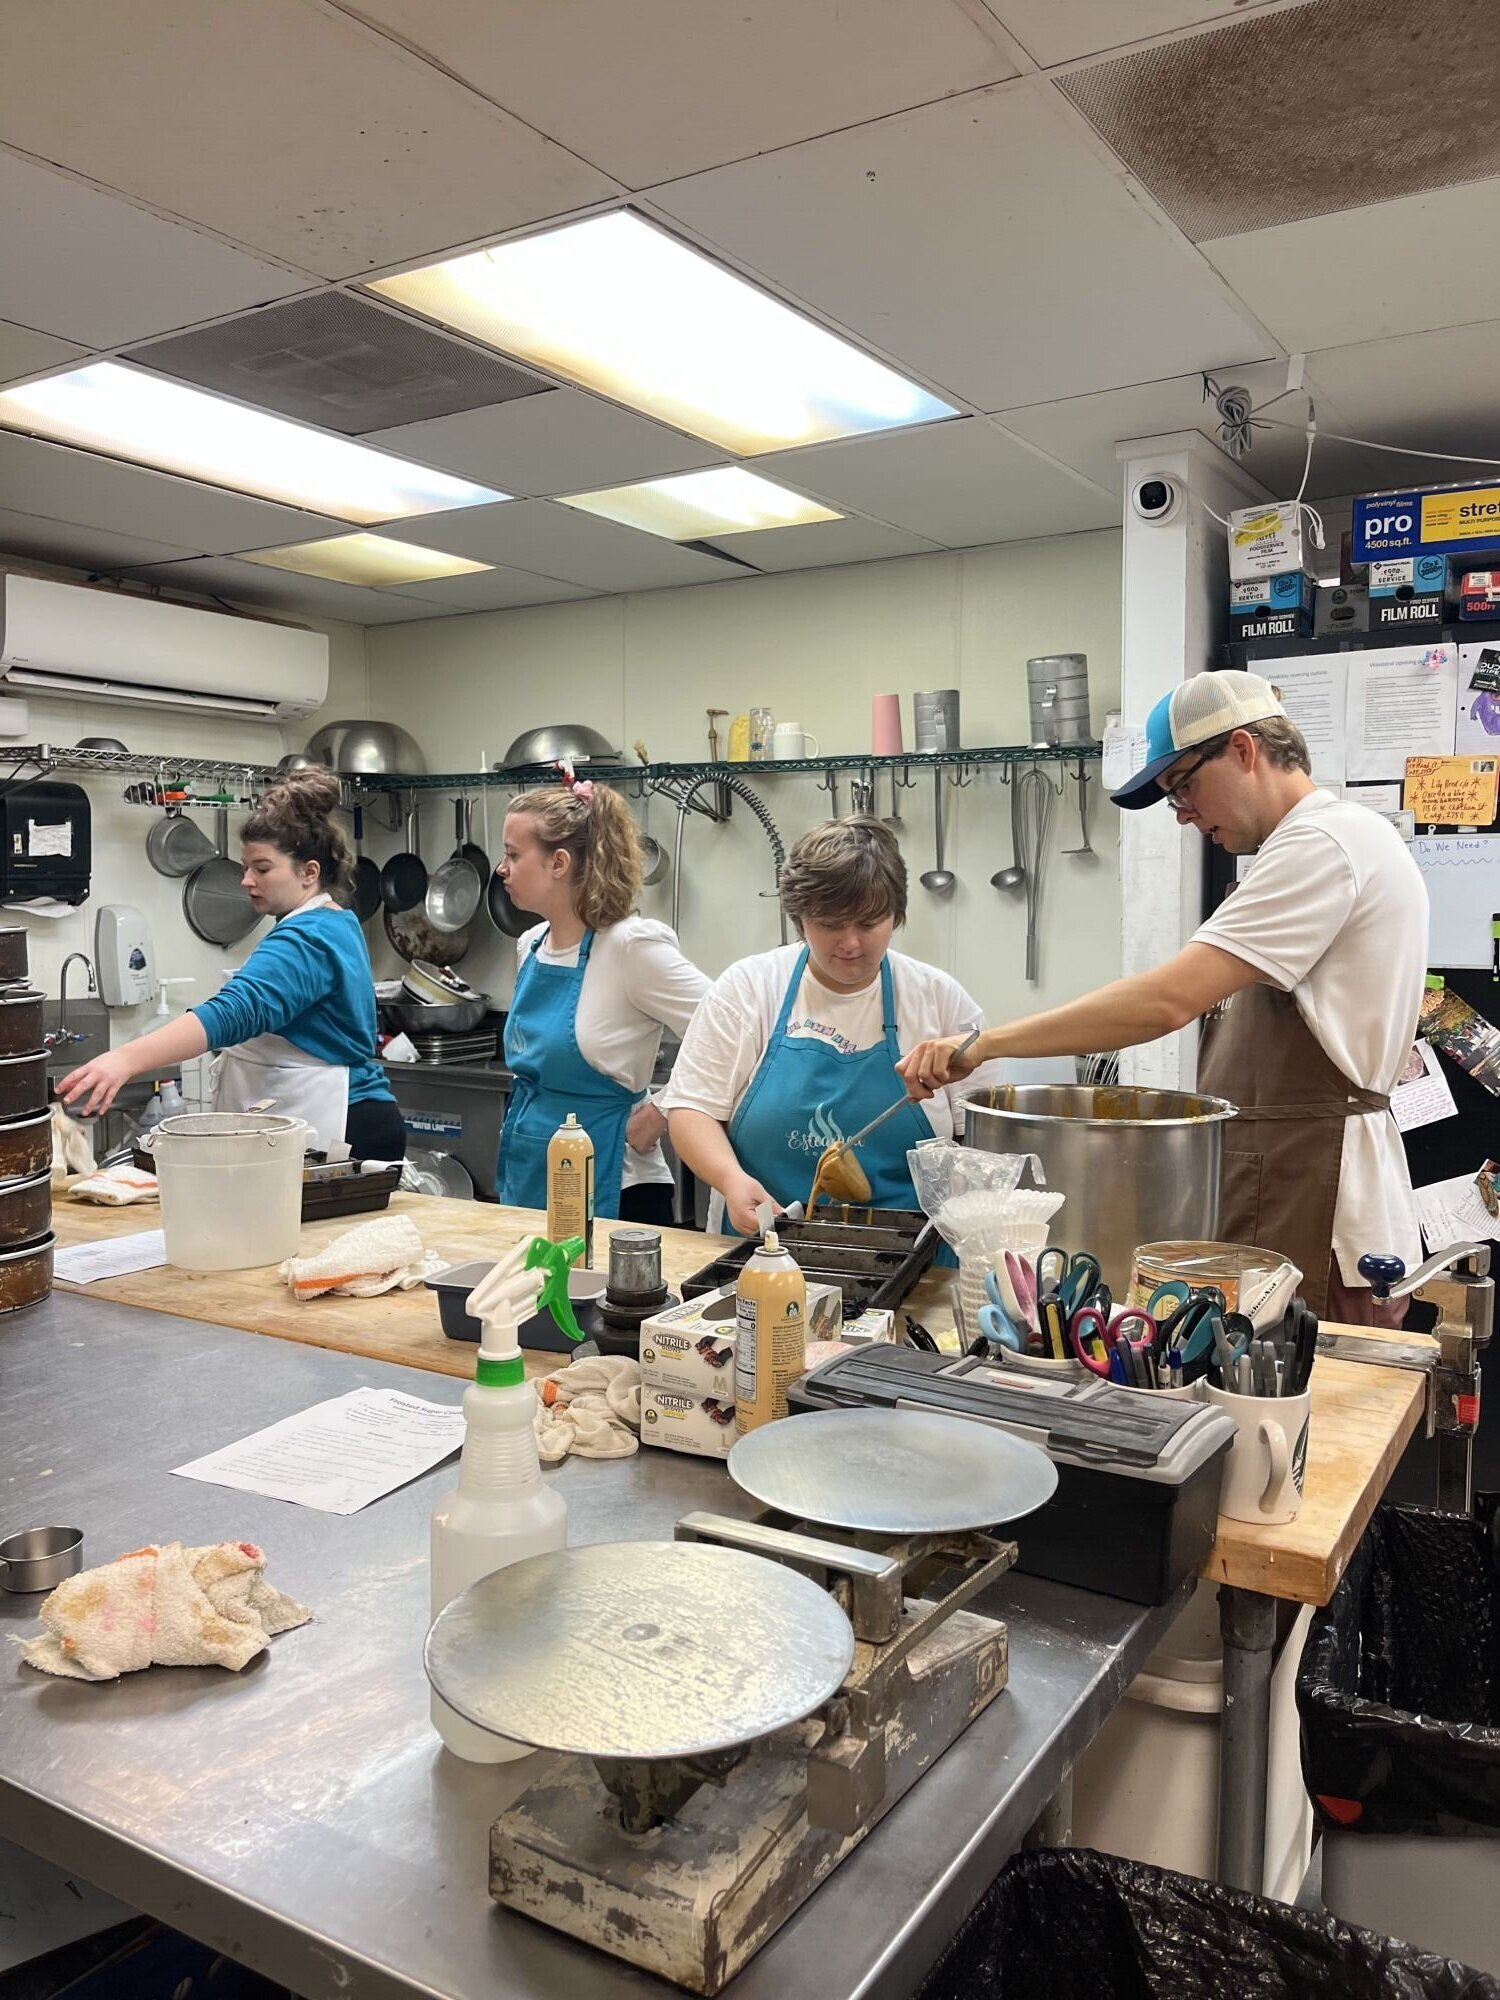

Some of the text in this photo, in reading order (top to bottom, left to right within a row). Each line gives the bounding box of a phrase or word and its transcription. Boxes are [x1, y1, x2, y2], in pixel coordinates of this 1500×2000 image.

[1366, 499, 1413, 510] polyvinyl films
[1459, 501, 1500, 518] stre
[1365, 515, 1413, 540] pro
[1365, 537, 1412, 549] 4500 sq.ft.
[1378, 575, 1406, 583] SERVICE
[1238, 593, 1264, 601] SERVICE
[1381, 606, 1408, 622] FILM
[1410, 604, 1439, 619] ROLL
[1242, 622, 1267, 637] FILM
[1268, 620, 1295, 635] ROLL
[1419, 841, 1431, 854] Do
[1435, 842, 1451, 852] We
[831, 1034, 857, 1054] HER
[787, 1130, 866, 1150] Estea
[1248, 1282, 1277, 1318] tchenAid
[655, 1335, 689, 1349] NITRILE
[713, 1375, 727, 1391] M
[388, 1397, 420, 1410] Frosted
[657, 1395, 692, 1409] NITRILE
